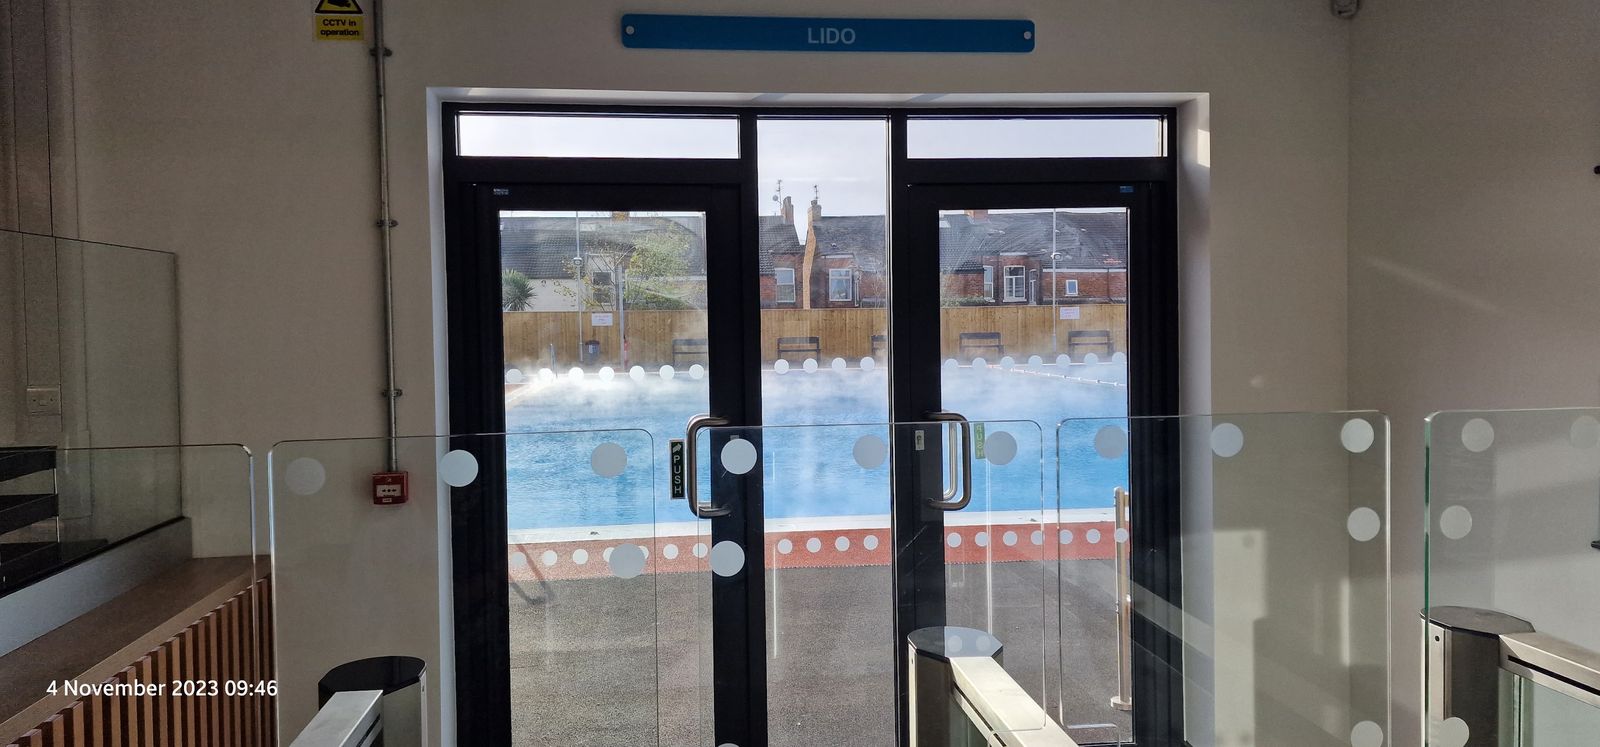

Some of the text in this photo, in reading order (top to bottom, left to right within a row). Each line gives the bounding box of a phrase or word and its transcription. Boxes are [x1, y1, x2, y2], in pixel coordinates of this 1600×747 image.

[322, 18, 346, 26] CCTV
[807, 27, 856, 44] LIDO
[673, 454, 682, 494] PUSH
